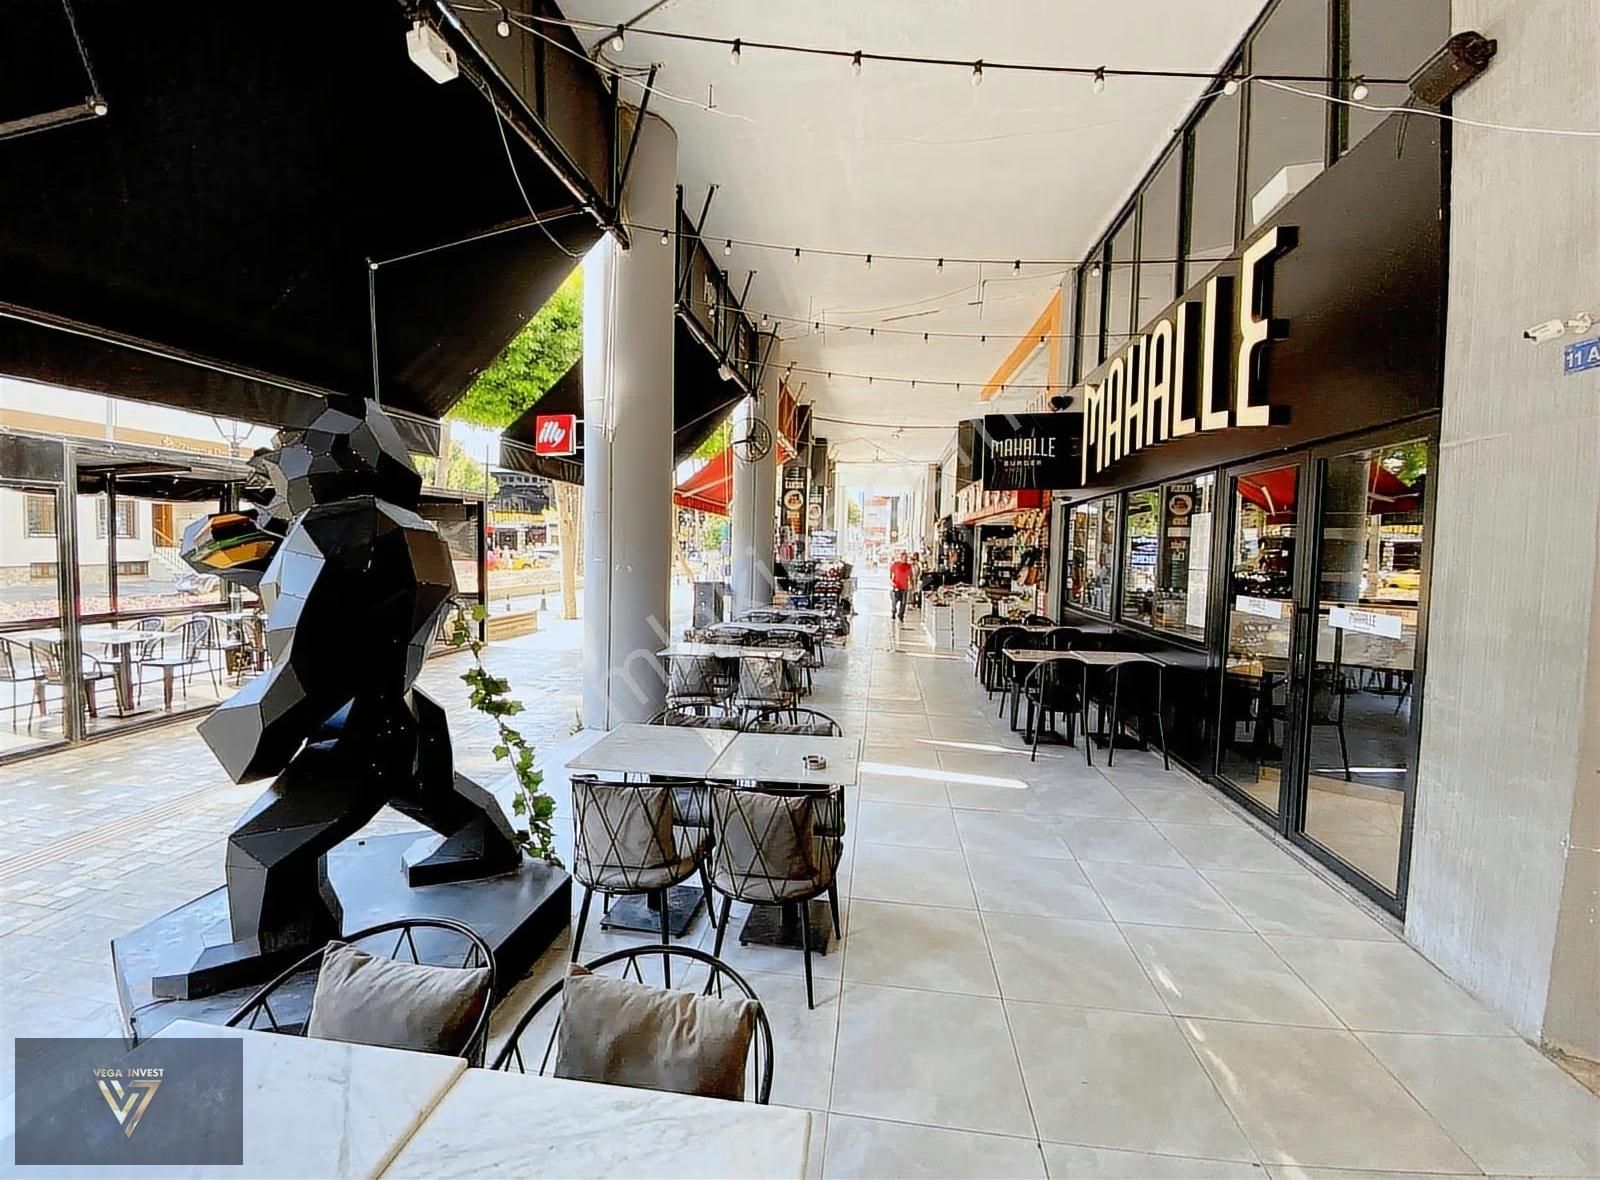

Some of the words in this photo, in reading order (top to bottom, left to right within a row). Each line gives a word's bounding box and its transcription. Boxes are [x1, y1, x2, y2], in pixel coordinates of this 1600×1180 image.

[1081, 225, 1278, 486] MAHALLE
[1566, 349, 1583, 368] 11
[1586, 345, 1600, 363] A
[538, 421, 566, 447] illy
[990, 437, 1056, 460] MAHALLE
